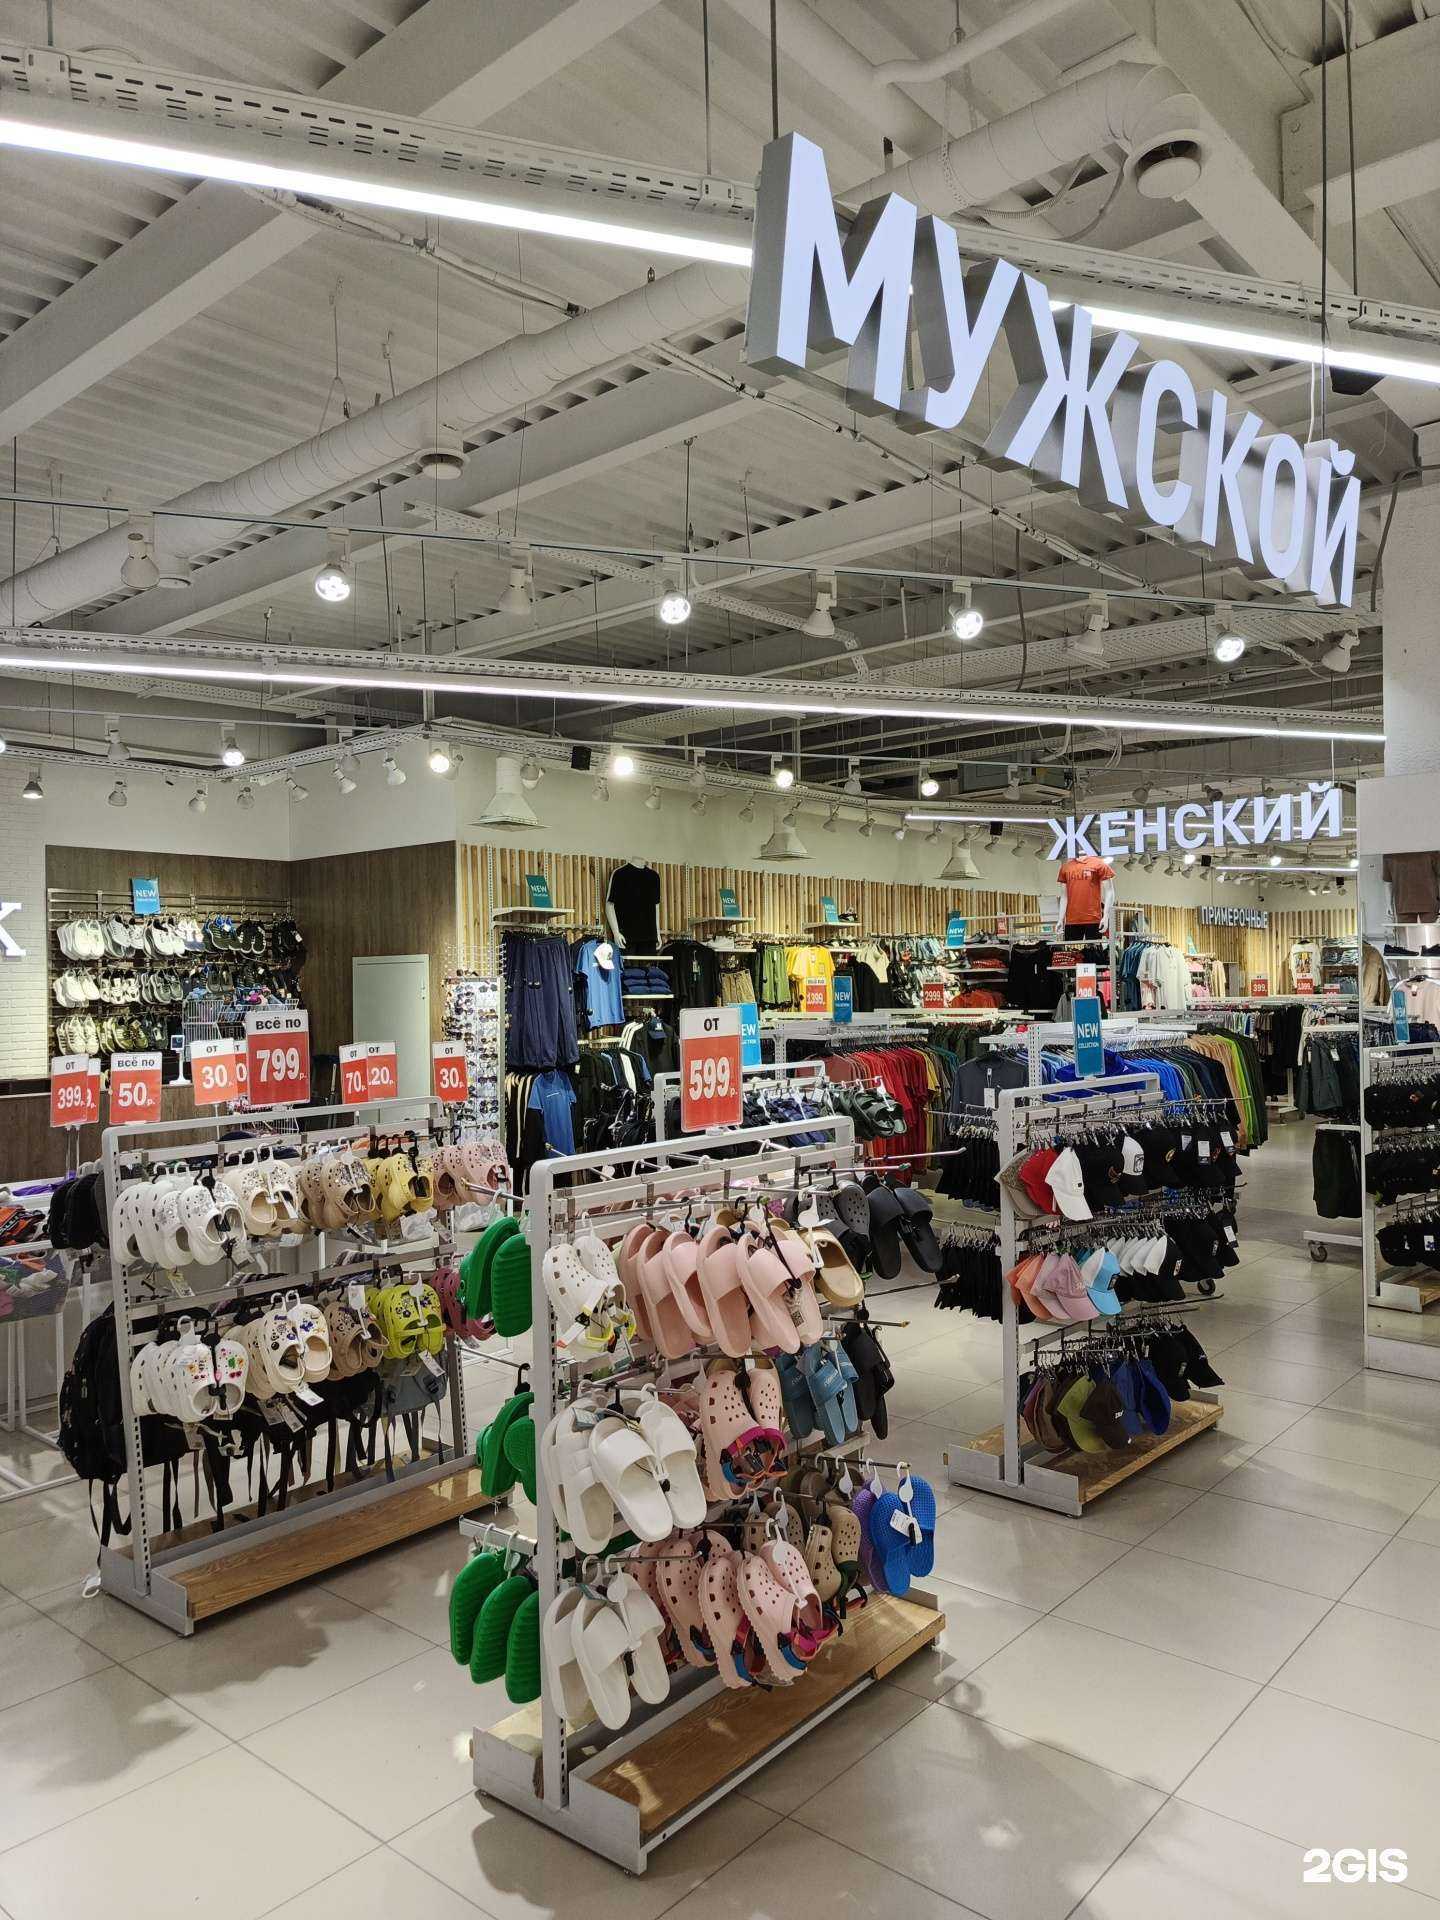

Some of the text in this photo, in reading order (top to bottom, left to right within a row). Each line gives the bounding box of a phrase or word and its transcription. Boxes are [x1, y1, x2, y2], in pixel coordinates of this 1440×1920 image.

[774, 131, 1361, 608] МУЖСКОЙ
[1046, 781, 1344, 861] ЖЕНСКИЙ
[136, 889, 157, 897] NEW
[1202, 906, 1268, 928] ПРИМЕРОЧНЫЕ
[949, 927, 965, 935] NEW
[834, 991, 851, 1001] NEW
[741, 1023, 757, 1036] EW
[1077, 1022, 1099, 1039] NEW
